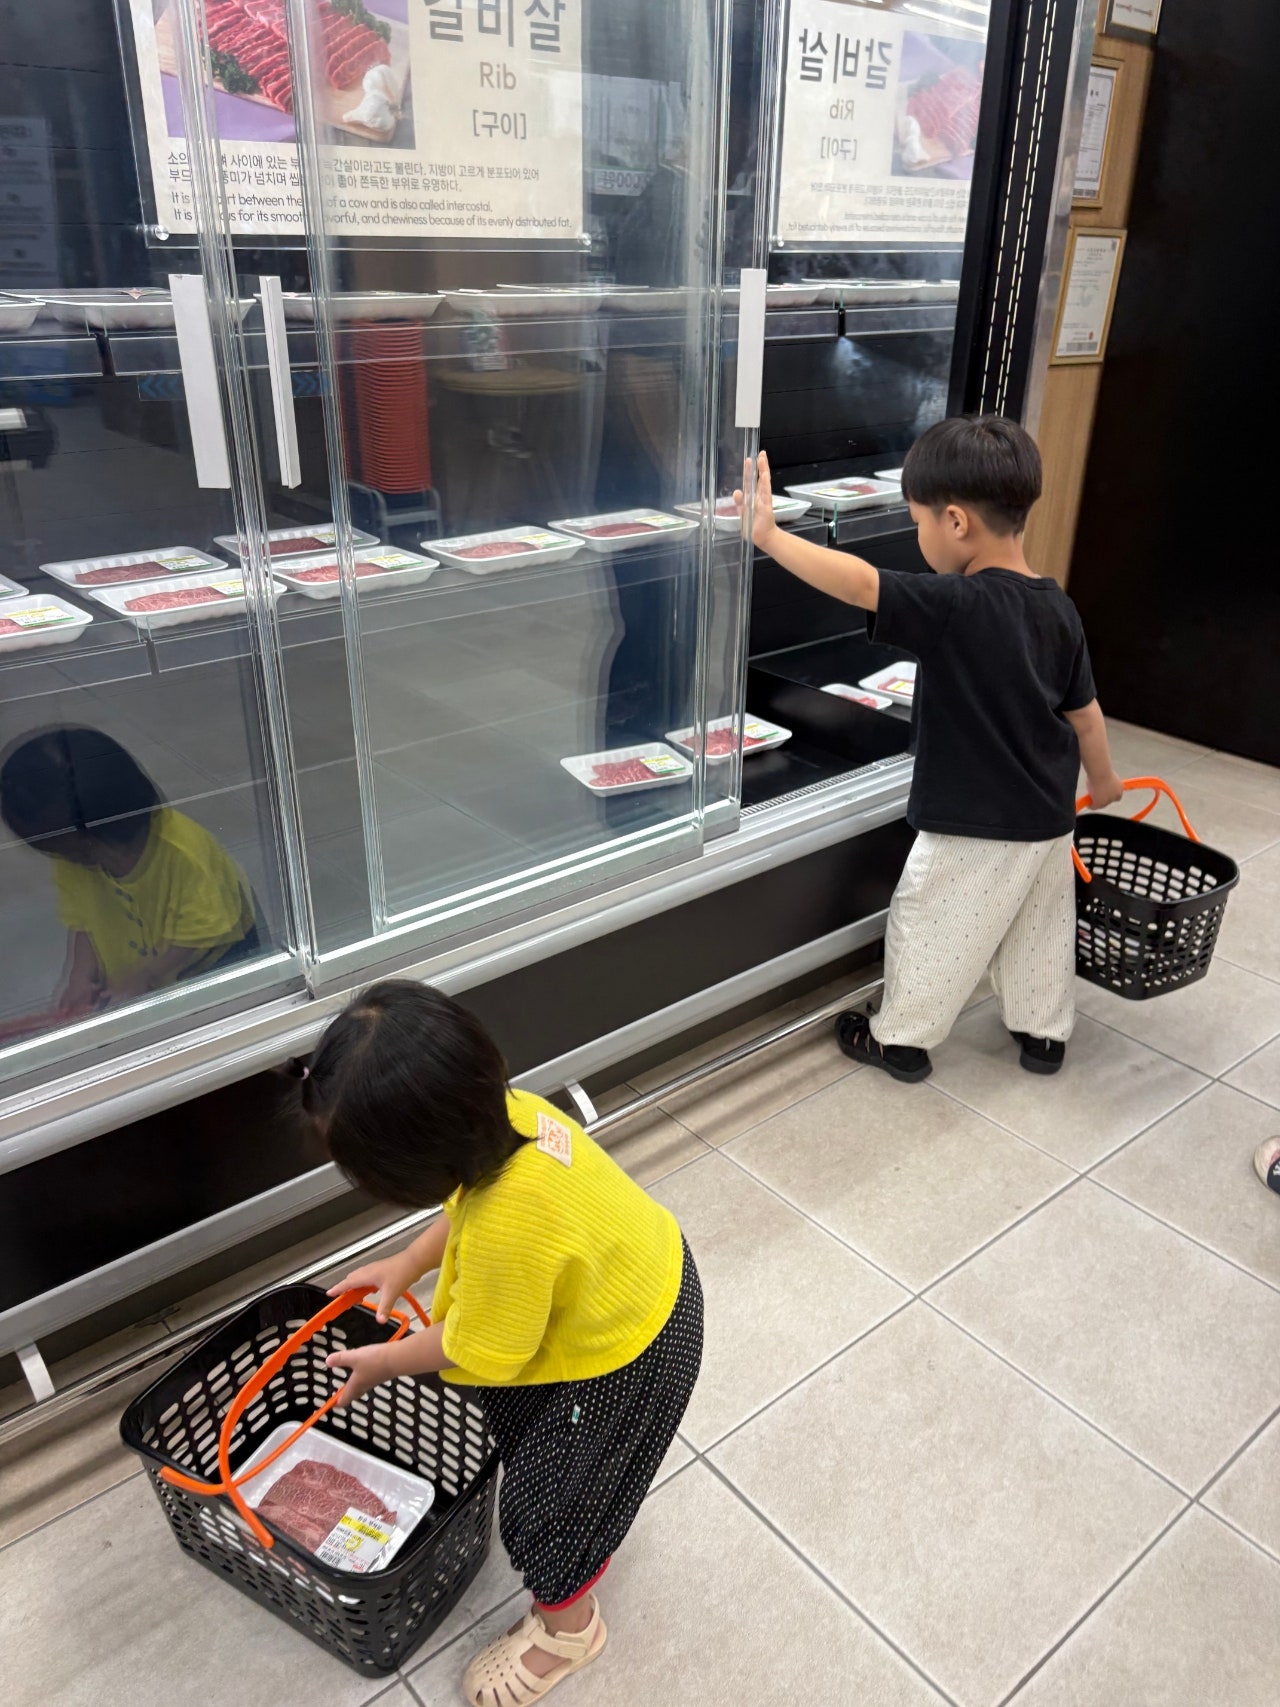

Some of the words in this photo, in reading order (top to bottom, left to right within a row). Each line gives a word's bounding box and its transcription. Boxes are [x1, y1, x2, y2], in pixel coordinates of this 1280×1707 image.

[424, 0, 566, 53] 갈비살
[479, 61, 517, 91] Rib
[472, 109, 527, 140] [구이]
[230, 153, 263, 168] 사이에
[266, 155, 287, 170] 있는
[428, 163, 456, 177] 지방이
[458, 165, 485, 178] 고르게
[522, 167, 540, 181] 있어
[254, 171, 287, 186] 넘치며
[360, 175, 390, 190] 쫀득한
[392, 177, 421, 191] 부위로
[422, 178, 462, 192] 유명하다.
[171, 192, 181, 204] It
[181, 192, 190, 204] is
[238, 193, 285, 207] between
[285, 194, 303, 207] the
[327, 195, 338, 208] of
[339, 199, 346, 209] a
[348, 199, 368, 209] cow
[370, 198, 389, 210] and
[391, 198, 398, 209] is
[399, 198, 418, 210] also
[419, 199, 445, 211] called
[446, 200, 493, 212] intercostal.
[174, 209, 182, 220] It
[184, 210, 193, 221] is
[239, 209, 255, 221] for
[256, 210, 269, 222] its
[270, 210, 303, 223] smoot
[361, 212, 380, 224] and
[382, 212, 428, 225] chewiness
[428, 213, 464, 226] because
[466, 214, 476, 226] of
[477, 215, 487, 226] its
[487, 216, 514, 229] evenly
[515, 216, 557, 227] distributed
[558, 216, 573, 228] fat.
